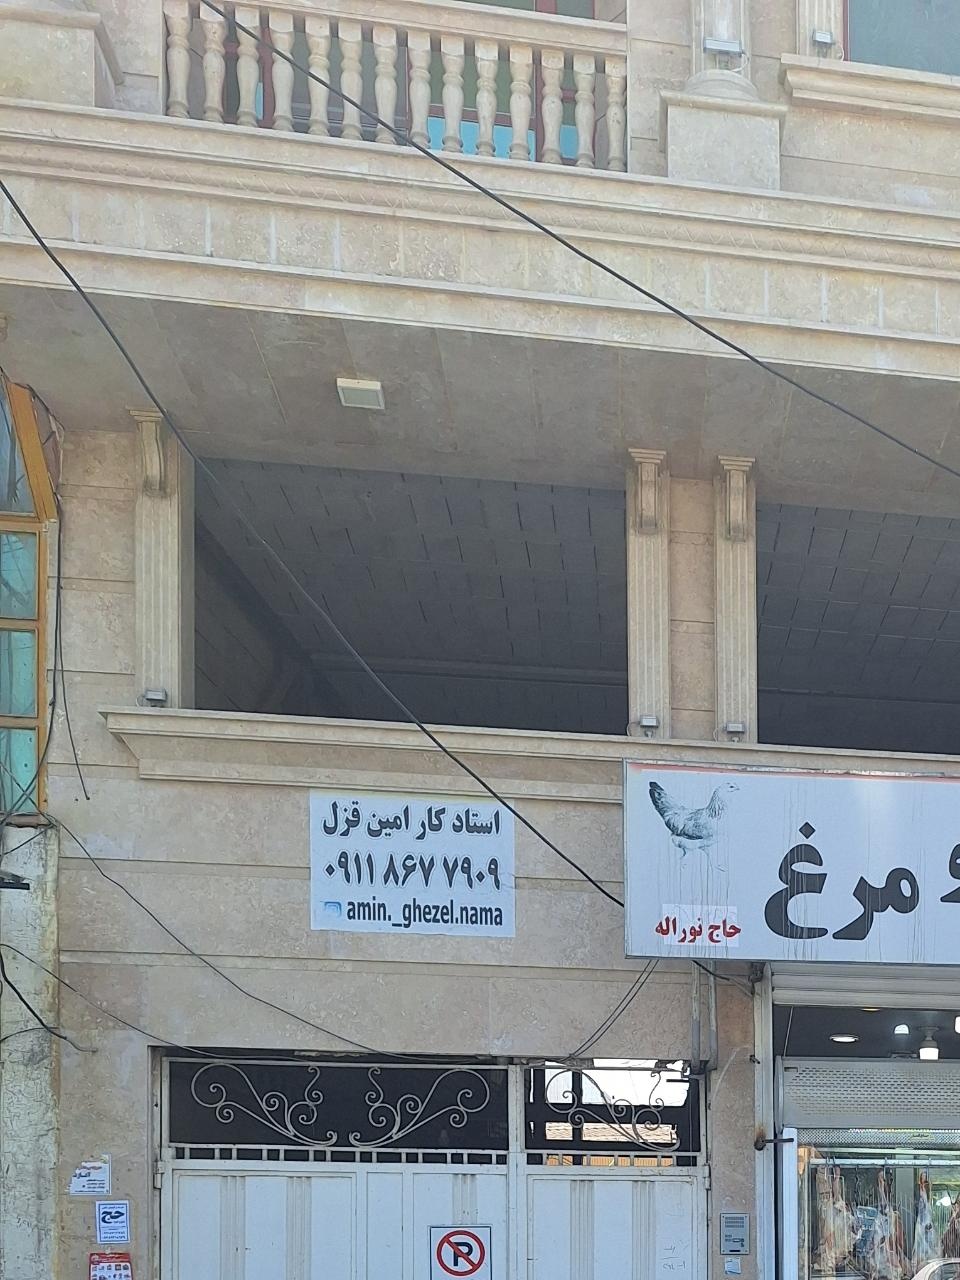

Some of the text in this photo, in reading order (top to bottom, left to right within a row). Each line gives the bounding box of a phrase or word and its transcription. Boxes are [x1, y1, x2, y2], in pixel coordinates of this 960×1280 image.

[323, 800, 500, 840] استاد کار امین قزل
[764, 821, 920, 941] مرغ
[708, 918, 741, 943] حاج
[101, 1210, 125, 1224] حج
